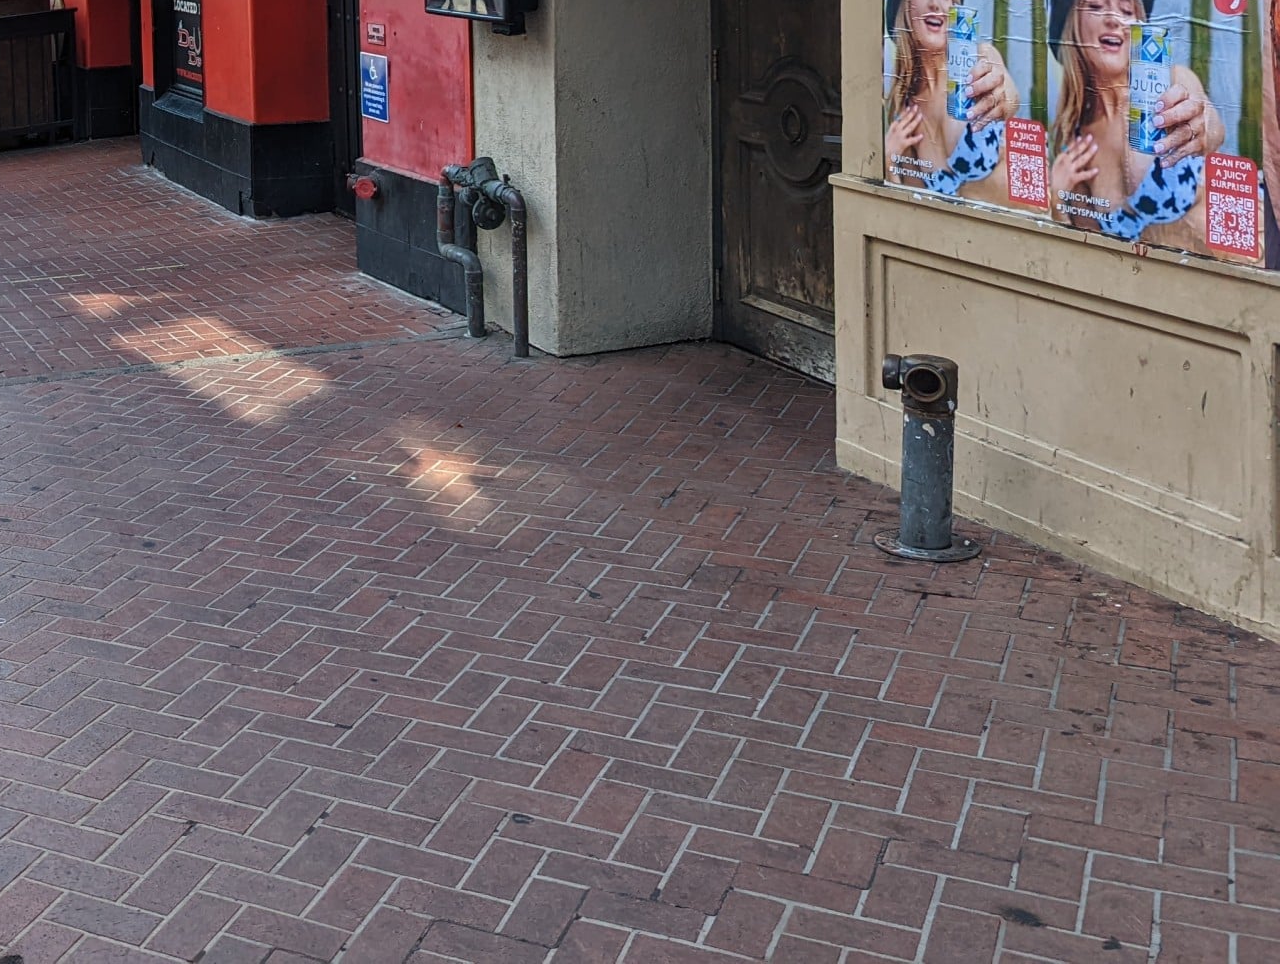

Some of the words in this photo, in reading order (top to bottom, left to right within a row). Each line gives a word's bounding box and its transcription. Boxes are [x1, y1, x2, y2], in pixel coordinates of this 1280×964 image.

[173, 0, 199, 14] LOCATED
[1009, 121, 1027, 130] SCAN
[1028, 124, 1042, 133] FOR
[1019, 133, 1038, 142] JUICY
[890, 154, 933, 168] @JUICYWINES
[1210, 157, 1234, 167] SCAN
[1235, 160, 1252, 171] FOR
[1223, 170, 1247, 181] JUICY
[1210, 180, 1253, 194] SURPRISE!
[1057, 190, 1111, 208] @JUICYWINES
[1056, 204, 1114, 223] #JUICYSPARKLE
